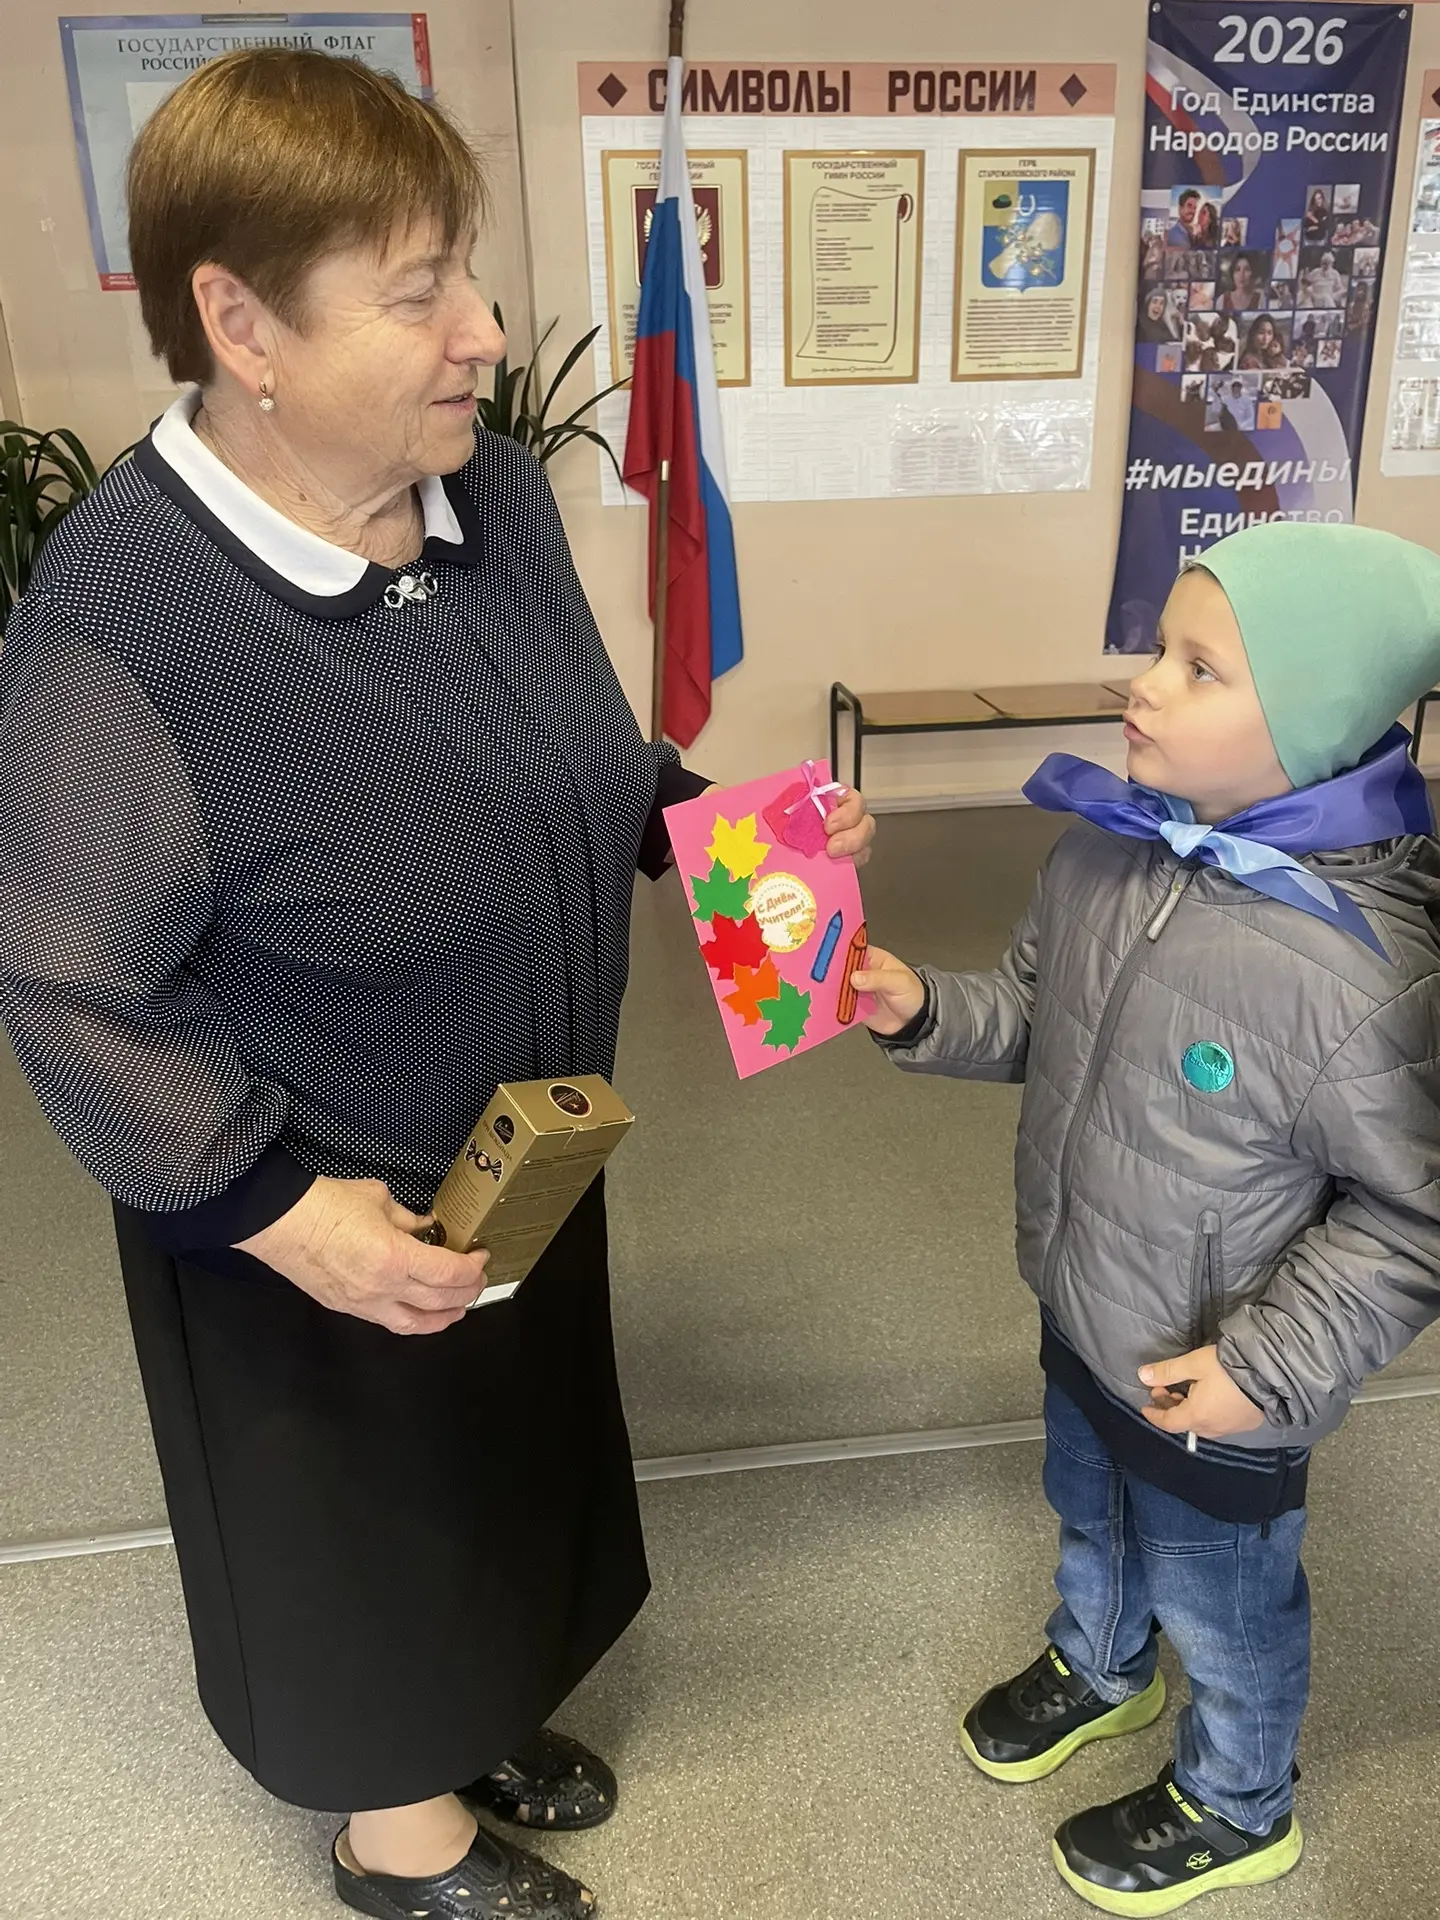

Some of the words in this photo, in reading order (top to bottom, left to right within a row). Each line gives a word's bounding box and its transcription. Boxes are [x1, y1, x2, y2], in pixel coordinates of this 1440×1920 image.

[118, 32, 313, 54] ГОСУДАРСТВЕННЫЙ
[323, 35, 376, 50] ФЛАГ
[1213, 14, 1348, 66] 2026
[141, 54, 214, 71] РОССИЙ
[648, 69, 851, 113] СИМВОЛЫ
[888, 70, 1037, 113] РОССИИ
[1171, 86, 1222, 115] Год
[1232, 87, 1376, 116] Единства
[1150, 125, 1279, 158] Народов
[1286, 126, 1390, 152] России
[850, 171, 885, 180] РОССИИ
[1126, 458, 1352, 491] #мыедины
[766, 892, 797, 912] Днём
